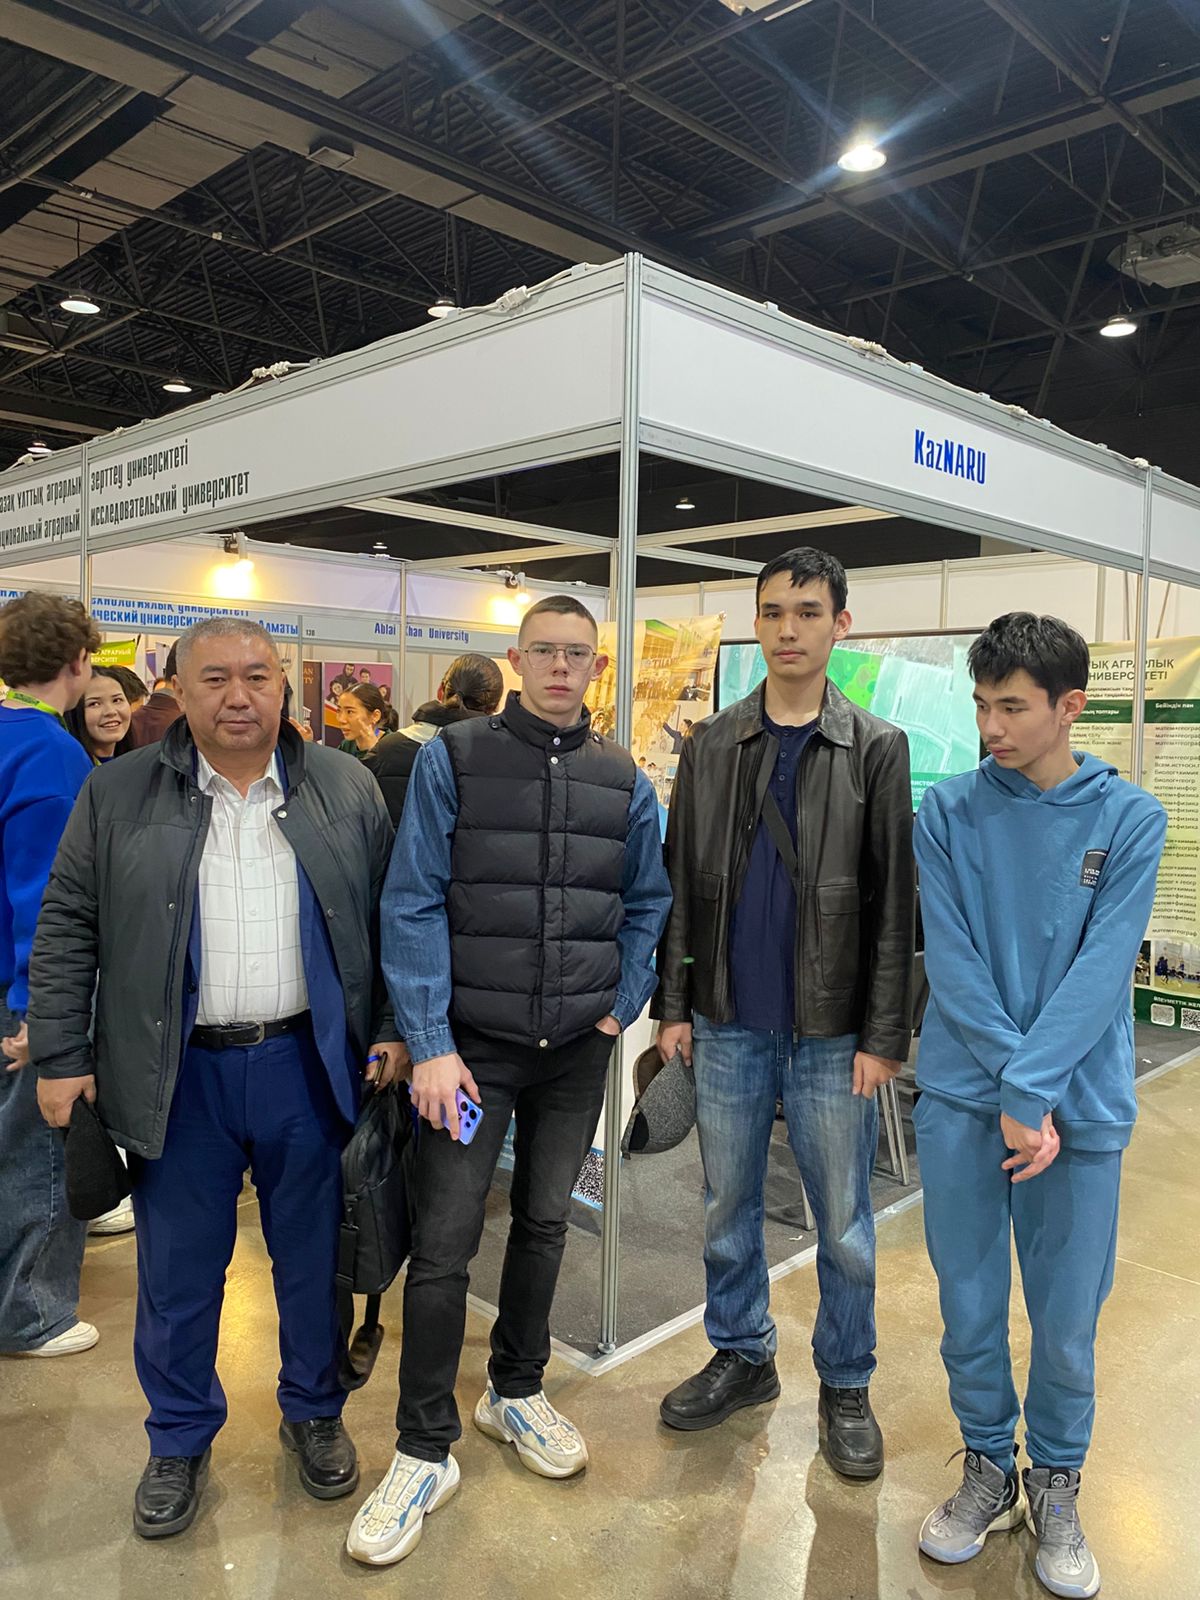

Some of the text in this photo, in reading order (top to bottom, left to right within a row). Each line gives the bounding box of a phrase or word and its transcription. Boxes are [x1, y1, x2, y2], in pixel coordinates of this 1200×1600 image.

[91, 463, 123, 494] зерттеу
[127, 438, 188, 487] университеті
[914, 428, 986, 485] KazNARU
[0, 471, 250, 550] циональный аграрный исследовательский университет
[374, 622, 396, 636] Ablai
[429, 627, 470, 643] University
[1089, 671, 1167, 681] НИВЕРСТЕТІ
[1111, 659, 1175, 669] АГРЛЫҚ
